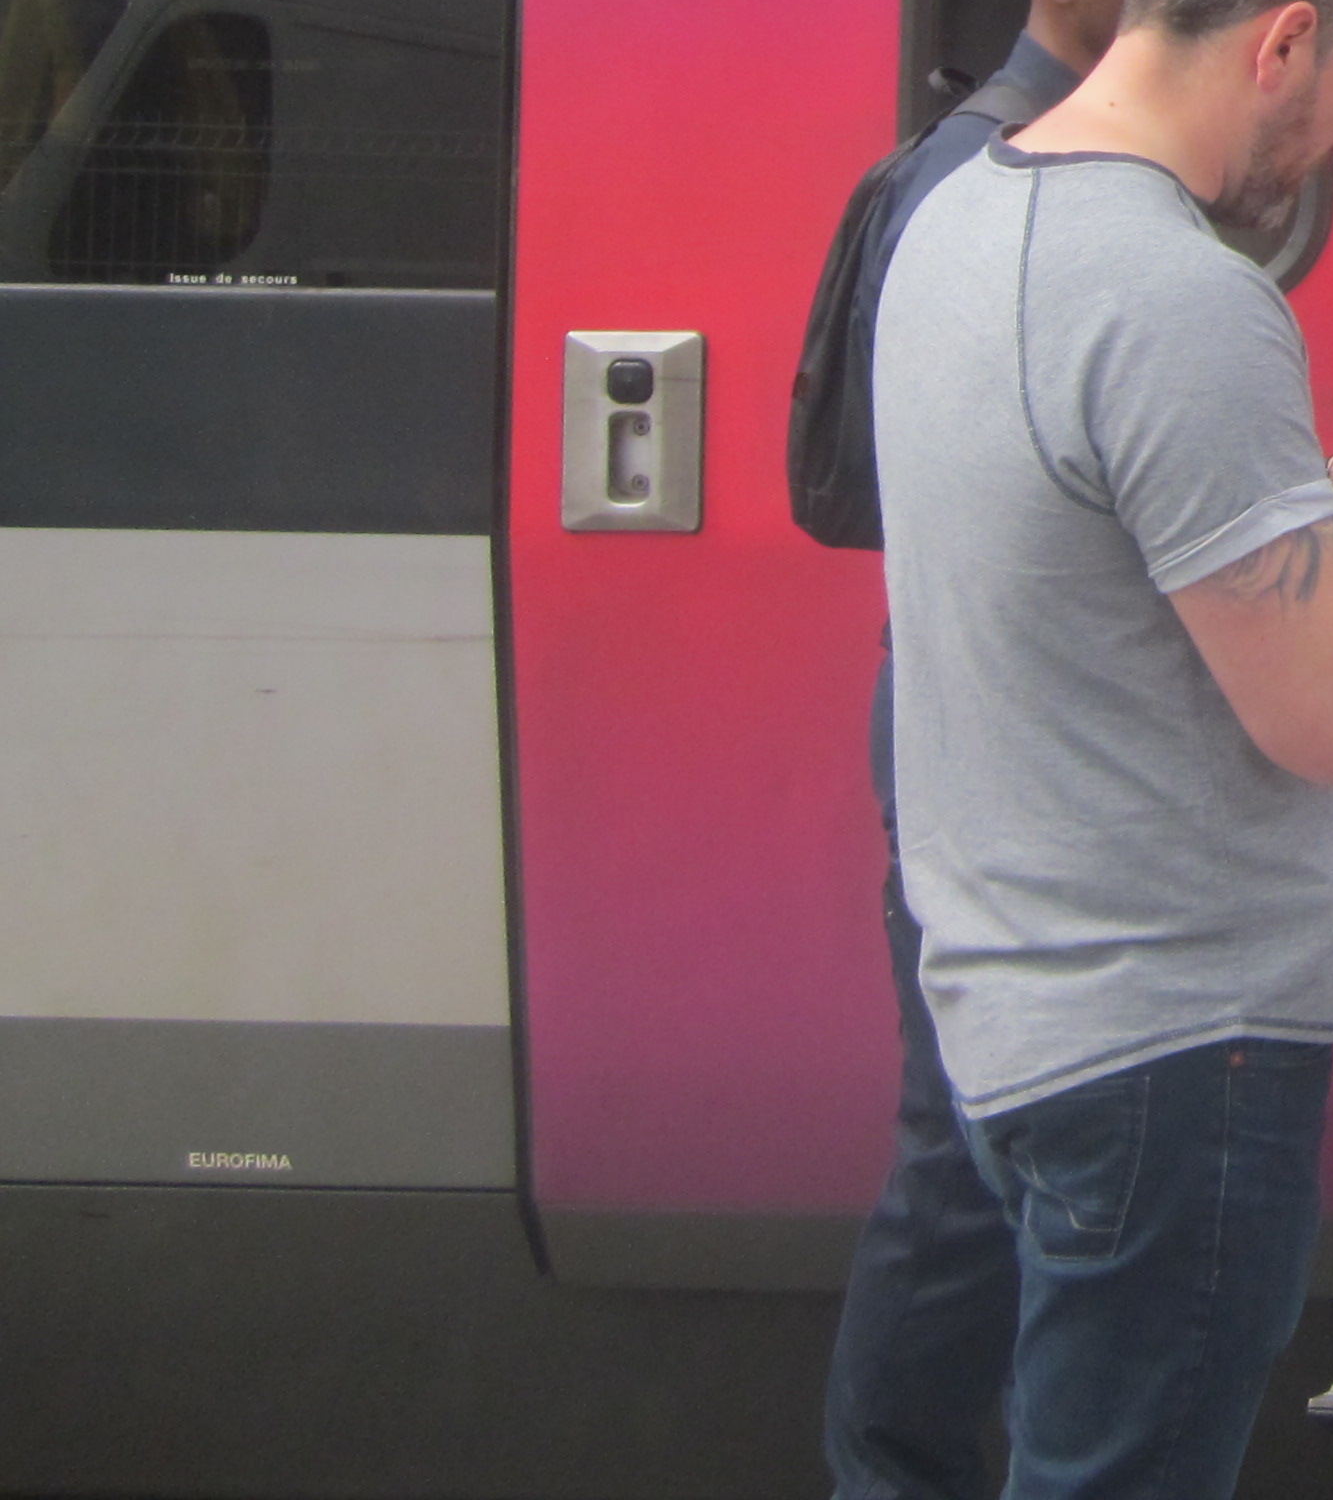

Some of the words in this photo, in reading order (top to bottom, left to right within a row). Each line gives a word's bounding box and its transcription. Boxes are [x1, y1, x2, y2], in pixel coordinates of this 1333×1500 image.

[169, 273, 206, 284] Issue
[215, 272, 232, 284] de
[241, 274, 298, 285] secours
[188, 1152, 292, 1170] EUROFIMA
